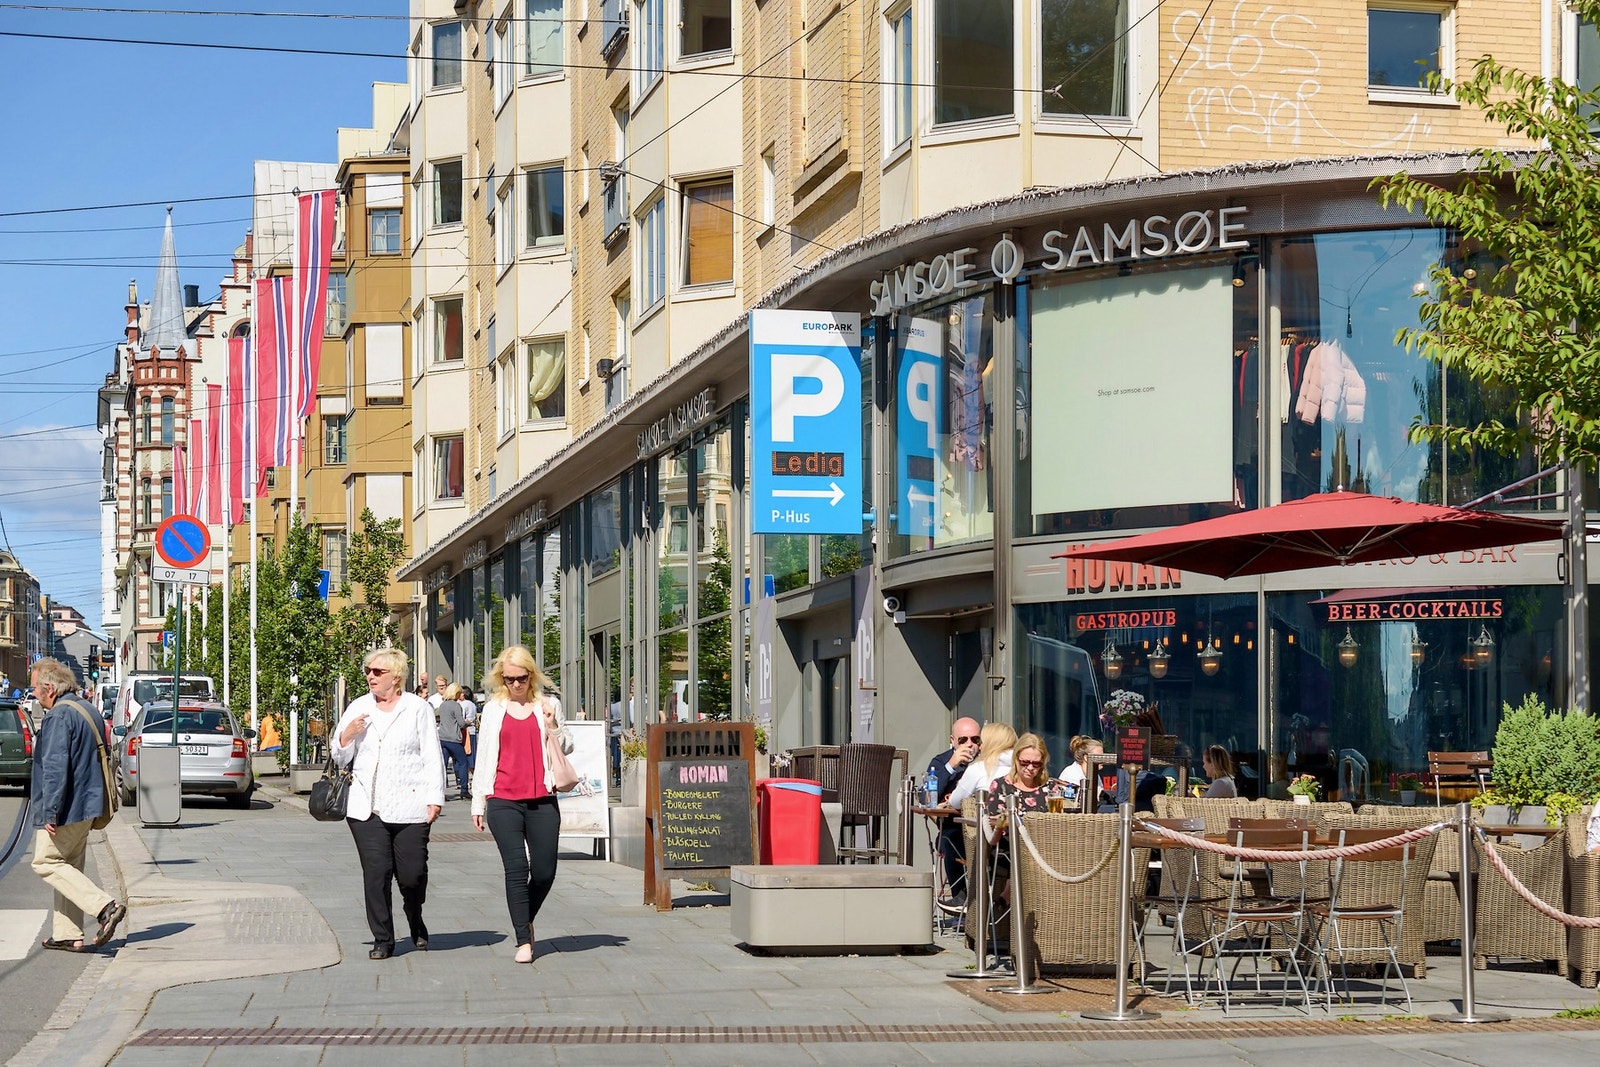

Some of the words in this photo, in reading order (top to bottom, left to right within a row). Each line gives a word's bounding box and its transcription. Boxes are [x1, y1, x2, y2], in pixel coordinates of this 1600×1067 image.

[868, 246, 978, 317] SAMSØE
[1041, 206, 1250, 271] SAMSØE
[802, 322, 854, 332] EUROPARK
[770, 354, 844, 442] P
[1098, 389, 1112, 397] Shop
[1120, 386, 1155, 394] samsoe.com
[636, 418, 666, 460] SAMSØE
[676, 386, 714, 434] SAMSØE
[772, 452, 844, 477] Ledig
[771, 509, 810, 524] P-Hus
[164, 570, 176, 578] 07
[189, 572, 197, 580] 17
[1328, 601, 1502, 620] BEER-COCKTAILS
[1076, 611, 1176, 630] GASTROPUB
[666, 730, 740, 758] HOMAN
